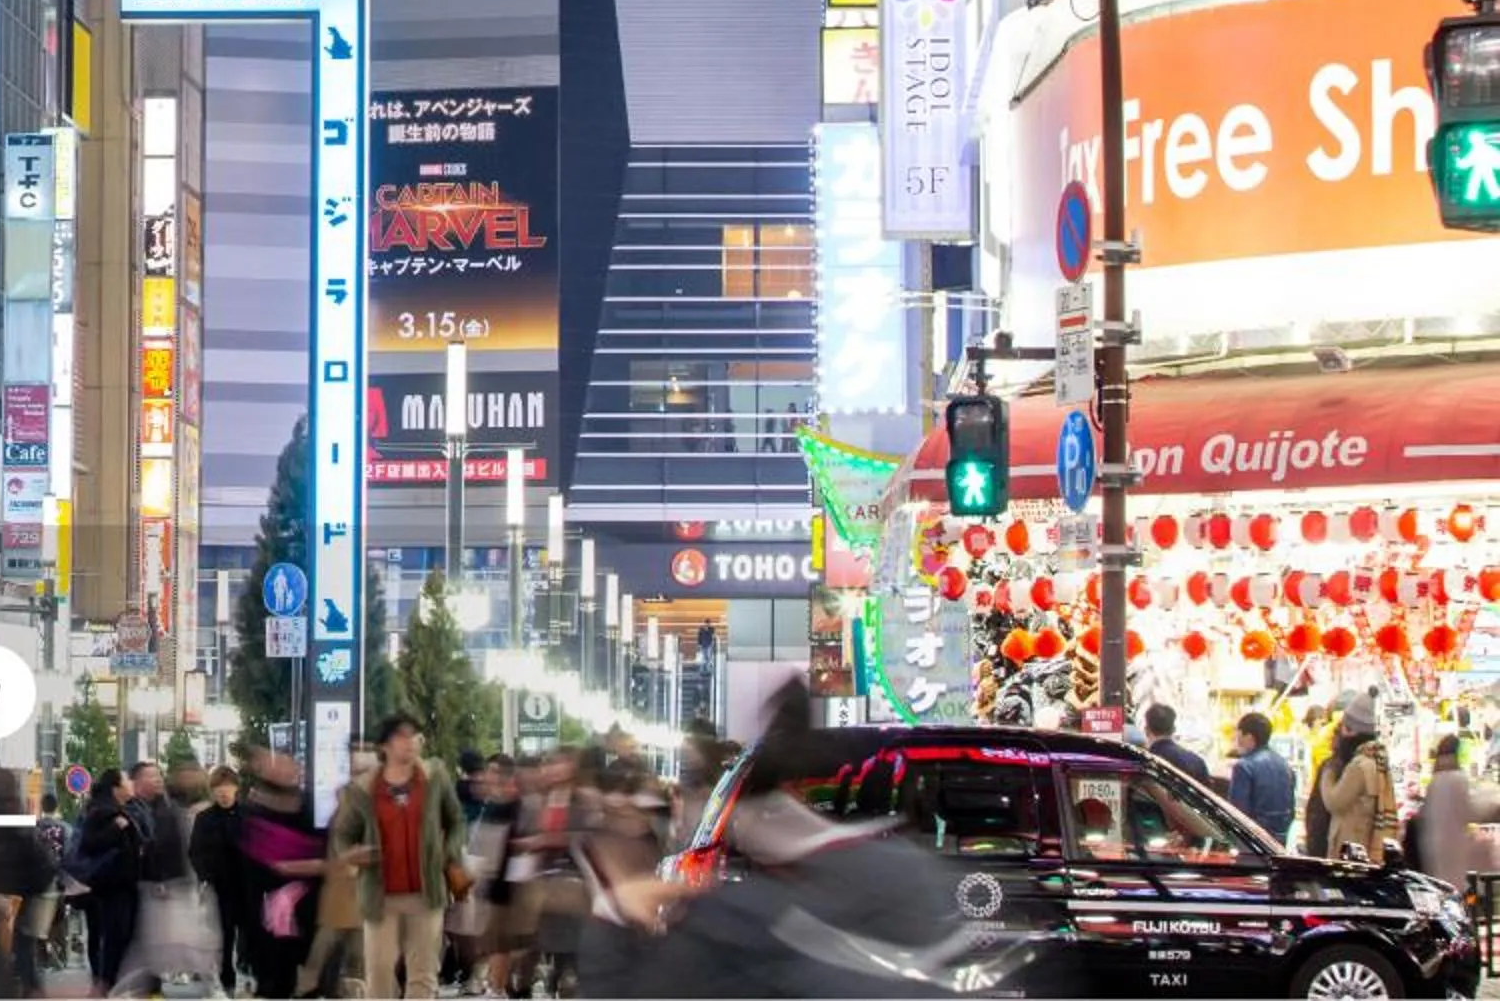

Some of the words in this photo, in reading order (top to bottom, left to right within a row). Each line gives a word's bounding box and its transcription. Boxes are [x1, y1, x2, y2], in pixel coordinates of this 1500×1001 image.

[906, 39, 927, 133] STAGE
[930, 39, 950, 115] IDOL
[387, 121, 496, 144] 誕生前の物語
[1122, 98, 1273, 208] Free
[376, 181, 499, 208] CAPTAIN
[906, 166, 949, 195] 5F
[323, 117, 354, 545] ゴジラロード
[402, 392, 545, 430] MAUHAN
[5, 444, 46, 461] Cafe
[1126, 439, 1184, 479] on
[1200, 428, 1368, 481] Quijote
[715, 556, 794, 580] TOHO
[1150, 974, 1187, 986] TAXI
